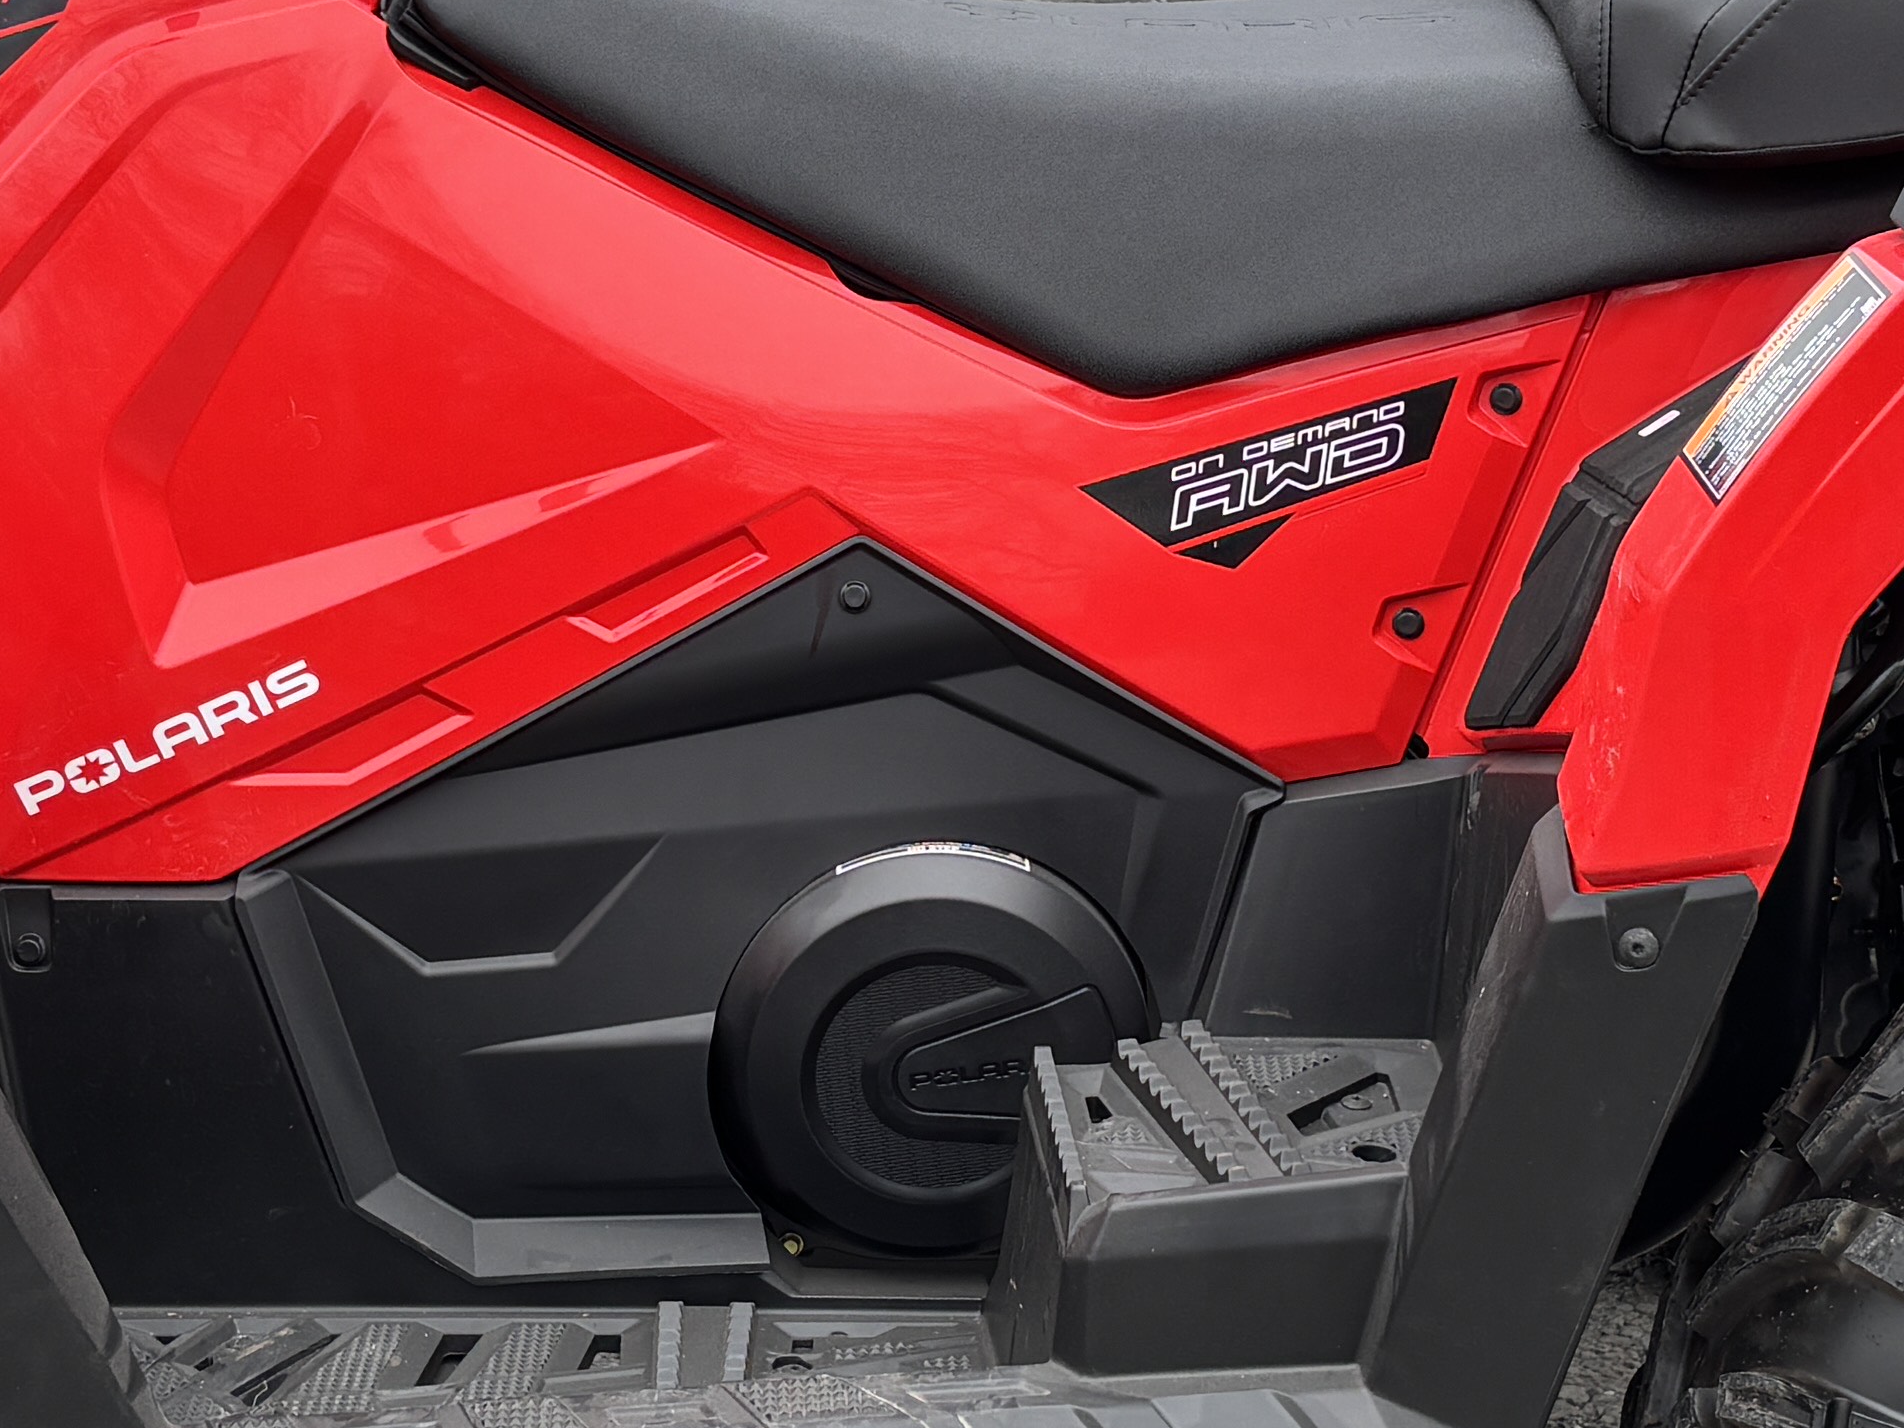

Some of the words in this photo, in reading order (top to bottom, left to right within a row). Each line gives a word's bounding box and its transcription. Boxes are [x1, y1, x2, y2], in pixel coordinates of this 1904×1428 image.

[1739, 305, 1811, 384] WARNING
[1170, 423, 1406, 532] AWD
[1171, 453, 1224, 482] ON
[1242, 400, 1405, 461] DEMAND
[13, 659, 320, 816] POLARIS
